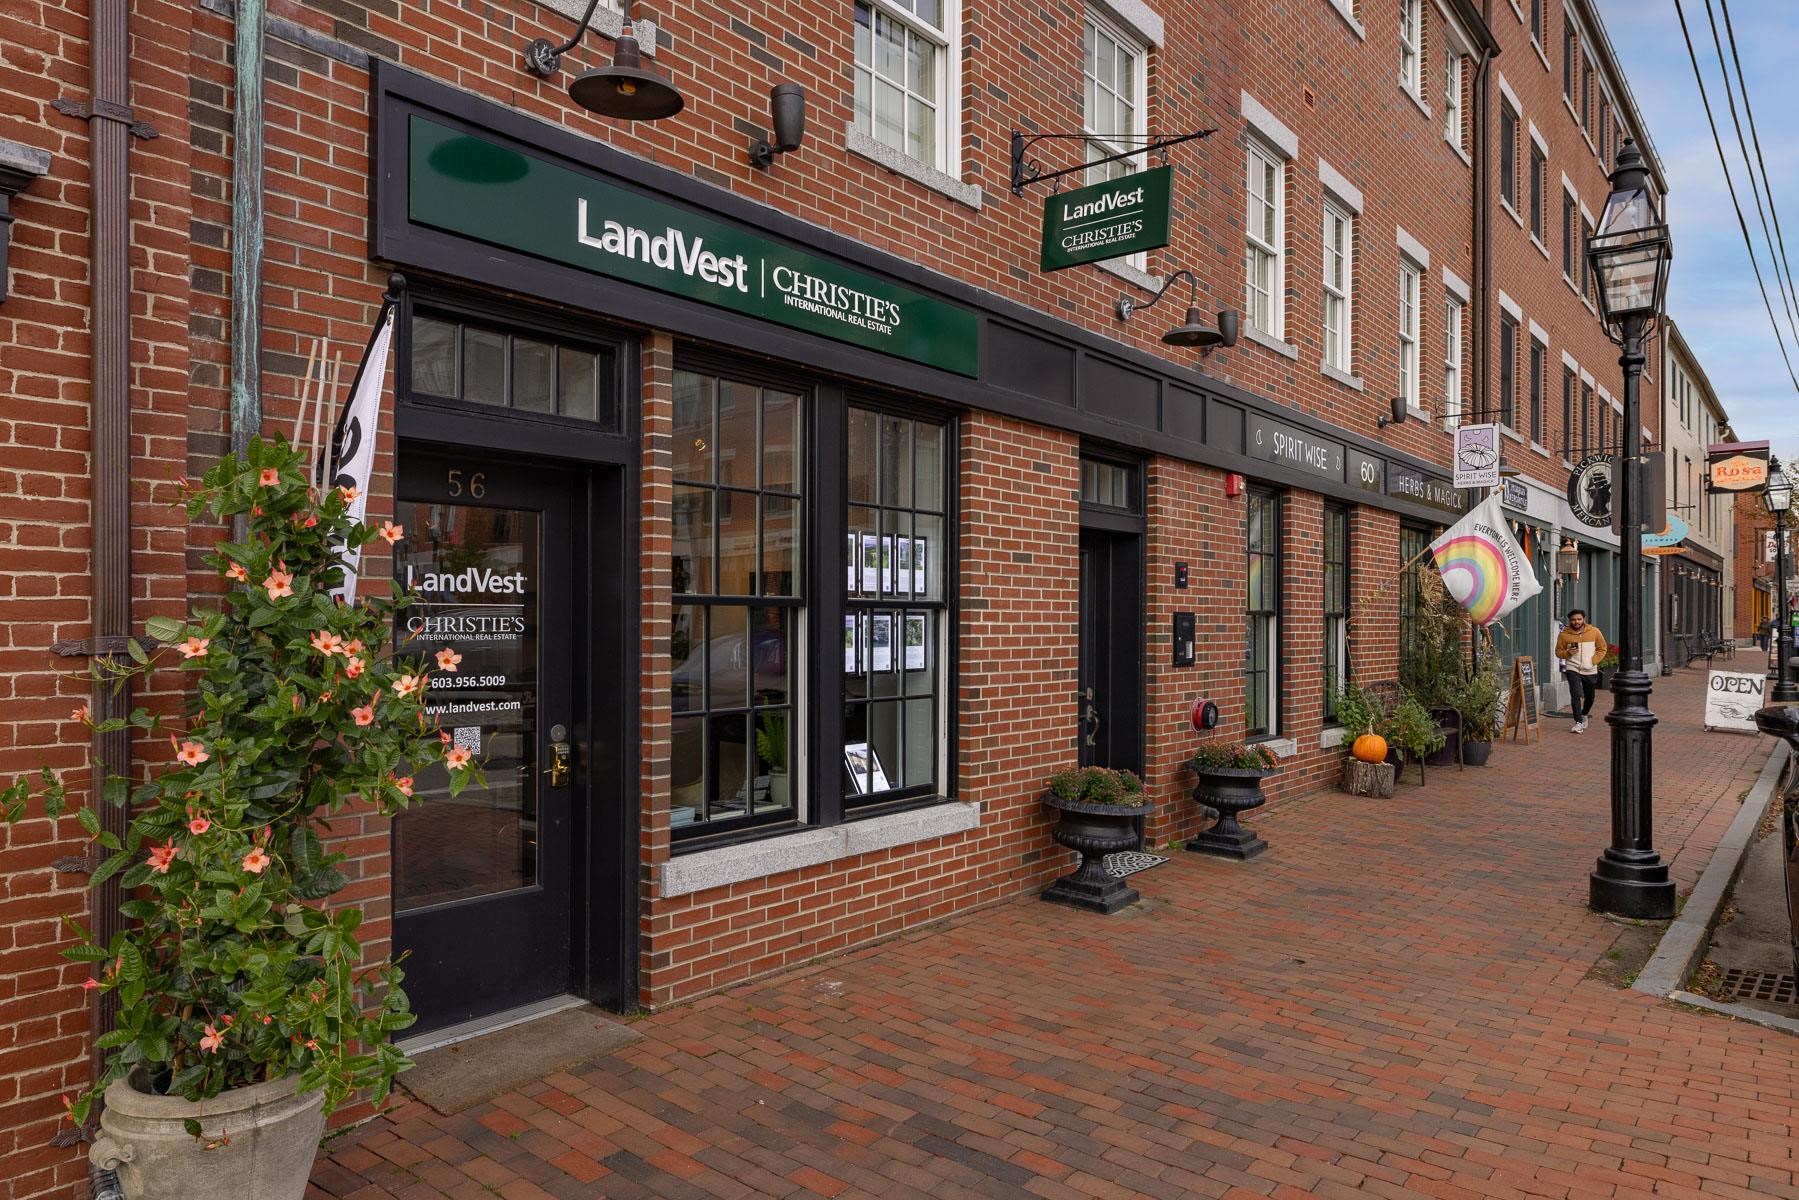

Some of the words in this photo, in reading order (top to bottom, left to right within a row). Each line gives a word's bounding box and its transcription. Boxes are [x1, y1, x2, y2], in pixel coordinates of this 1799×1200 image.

[1063, 186, 1144, 221] LandVest
[577, 197, 748, 293] LandVest
[1061, 219, 1143, 249] CHRISTIE'S
[1067, 240, 1105, 253] INTERNATIONAL
[1105, 237, 1117, 245] REAL
[1118, 232, 1136, 241] ESTATE
[772, 265, 901, 326] CHRISTIE'S
[784, 294, 847, 322] INTERNATIONAL
[848, 314, 866, 328] REAL
[867, 320, 892, 336] ESTATE
[1273, 431, 1303, 462] SPIRIT
[1304, 443, 1327, 470] WISE
[1360, 461, 1374, 484] 60
[1455, 473, 1477, 481] SPIRIT
[1478, 471, 1497, 479] WISE
[1573, 454, 1614, 476] PICKWIC
[448, 469, 486, 499] 56
[1399, 475, 1424, 498] HERBS
[1426, 484, 1432, 500] &
[1434, 486, 1462, 509] MAGICK
[1571, 504, 1611, 526] MERCAN
[1474, 523, 1503, 542] EVERYONE
[1500, 538, 1508, 548] IS
[1504, 546, 1520, 581] WELCOME
[407, 565, 526, 594] LandVest
[1510, 582, 1520, 602] HERE
[407, 616, 525, 633] CHRISTIE'S
[416, 633, 473, 641] INTERNATIONAL
[431, 675, 506, 689] 603.956.5009
[1711, 675, 1764, 695] OPEN
[425, 700, 521, 715] ww.landvest.com
